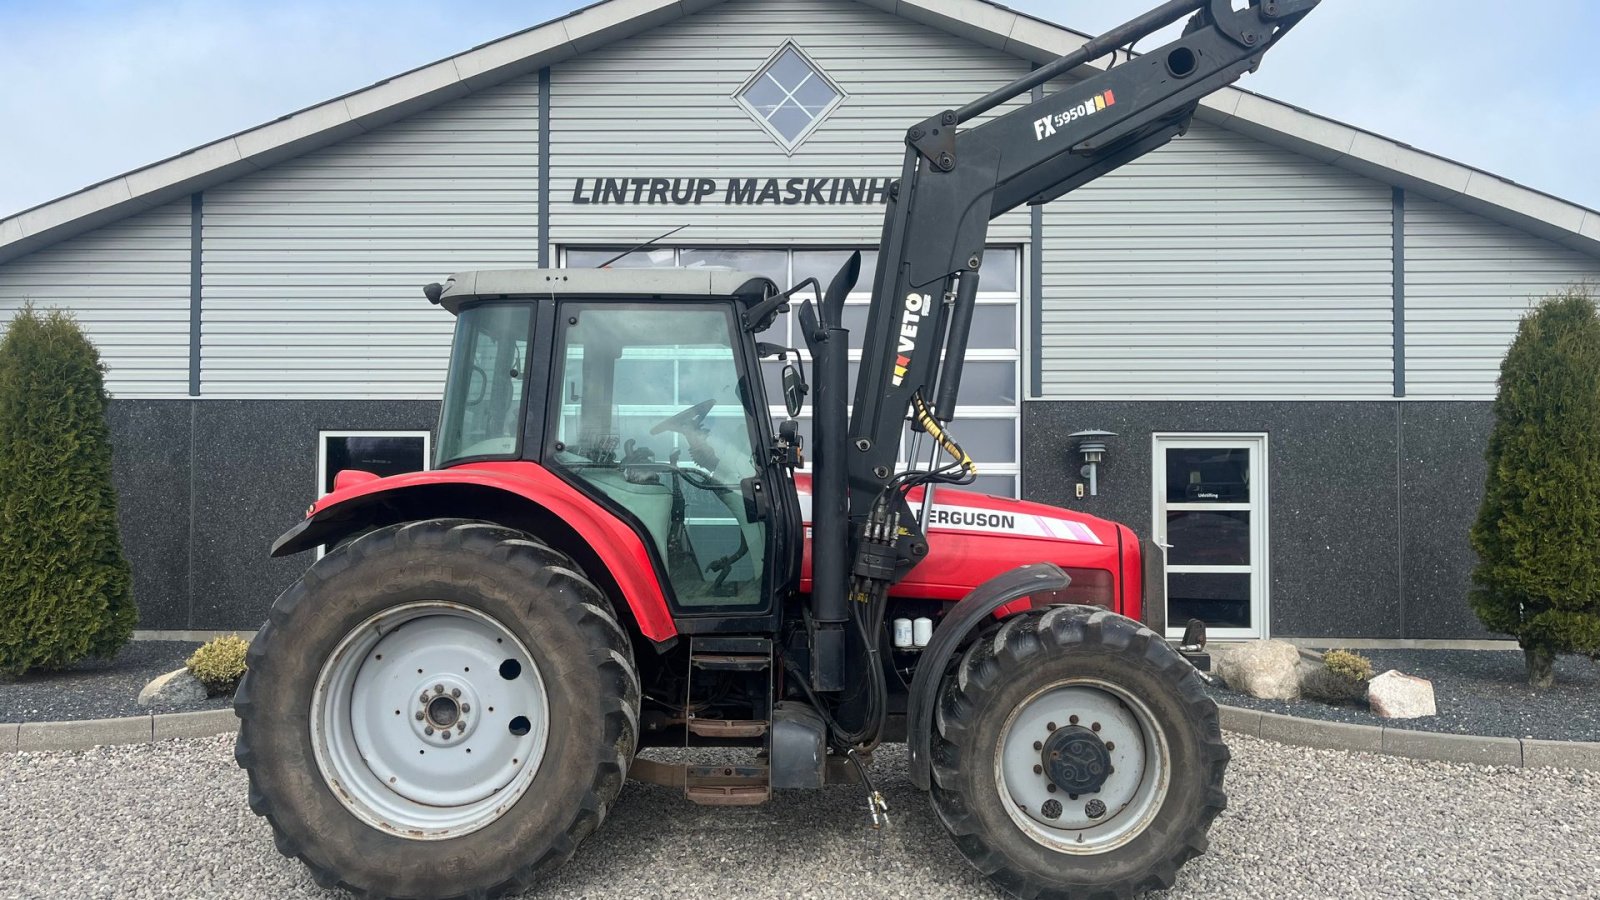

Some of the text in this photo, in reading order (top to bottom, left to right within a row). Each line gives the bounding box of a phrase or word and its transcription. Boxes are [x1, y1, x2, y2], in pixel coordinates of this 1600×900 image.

[1033, 104, 1086, 141] FX 5950
[572, 177, 716, 204] LINTRUP
[897, 292, 923, 353] VETO
